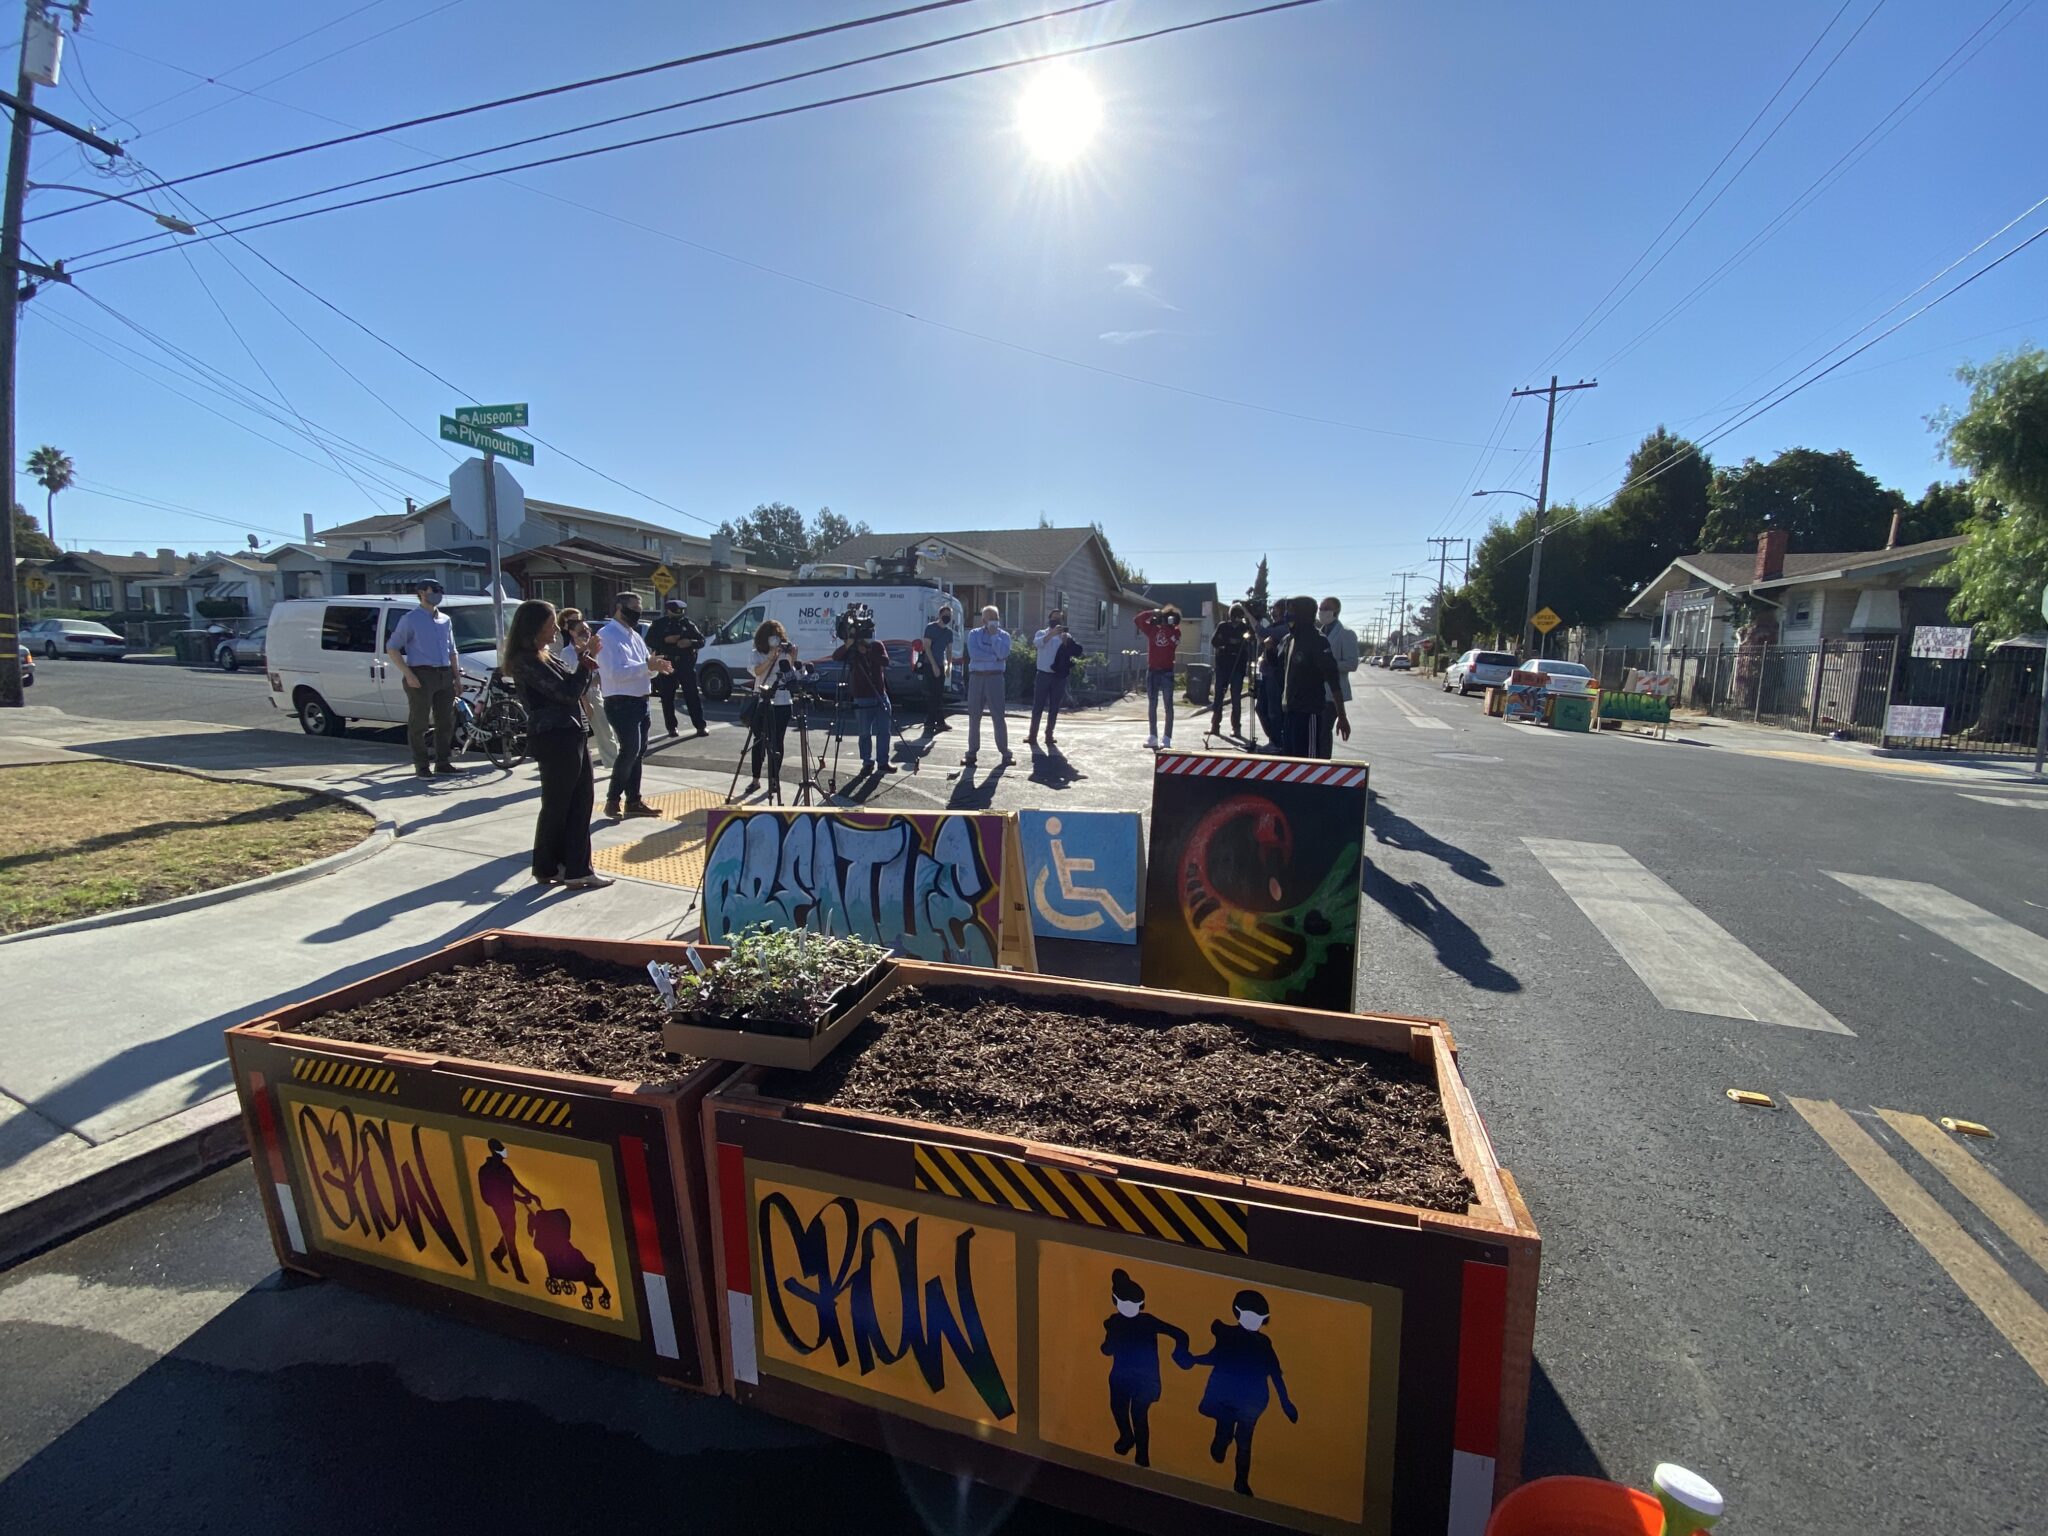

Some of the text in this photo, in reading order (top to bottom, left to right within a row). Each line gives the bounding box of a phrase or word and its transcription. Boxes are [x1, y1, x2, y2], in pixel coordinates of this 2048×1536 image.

[471, 411, 513, 425] Auseon
[459, 424, 519, 457] Plymouth
[799, 607, 821, 618] NBC
[300, 1105, 469, 1267] GROW
[759, 1191, 1015, 1421] GROW
